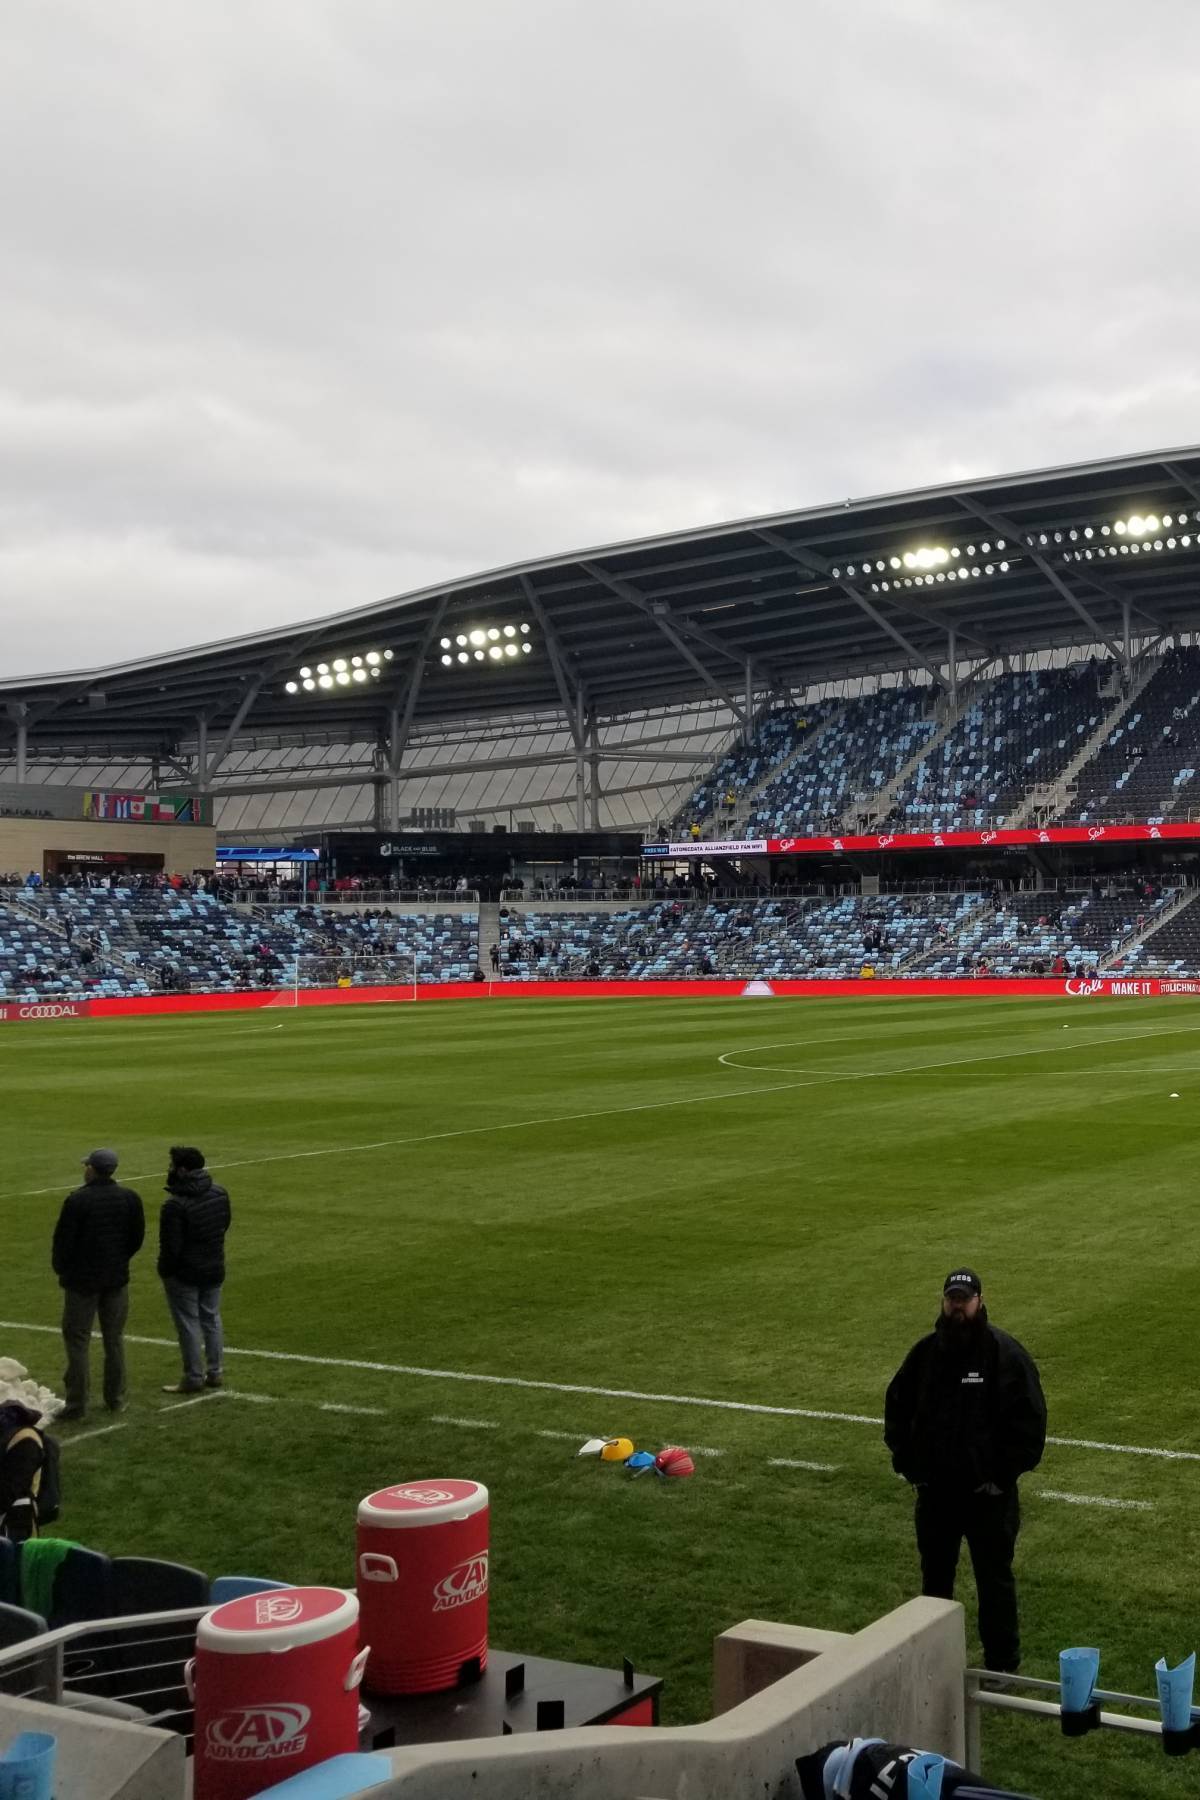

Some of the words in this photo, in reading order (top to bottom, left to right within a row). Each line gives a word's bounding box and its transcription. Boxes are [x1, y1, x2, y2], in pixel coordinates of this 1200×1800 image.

[1089, 827, 1106, 840] Stoli
[1111, 982, 1139, 995] MAKE
[1142, 982, 1152, 995] IT
[204, 1733, 307, 1760] ADVOCARE
